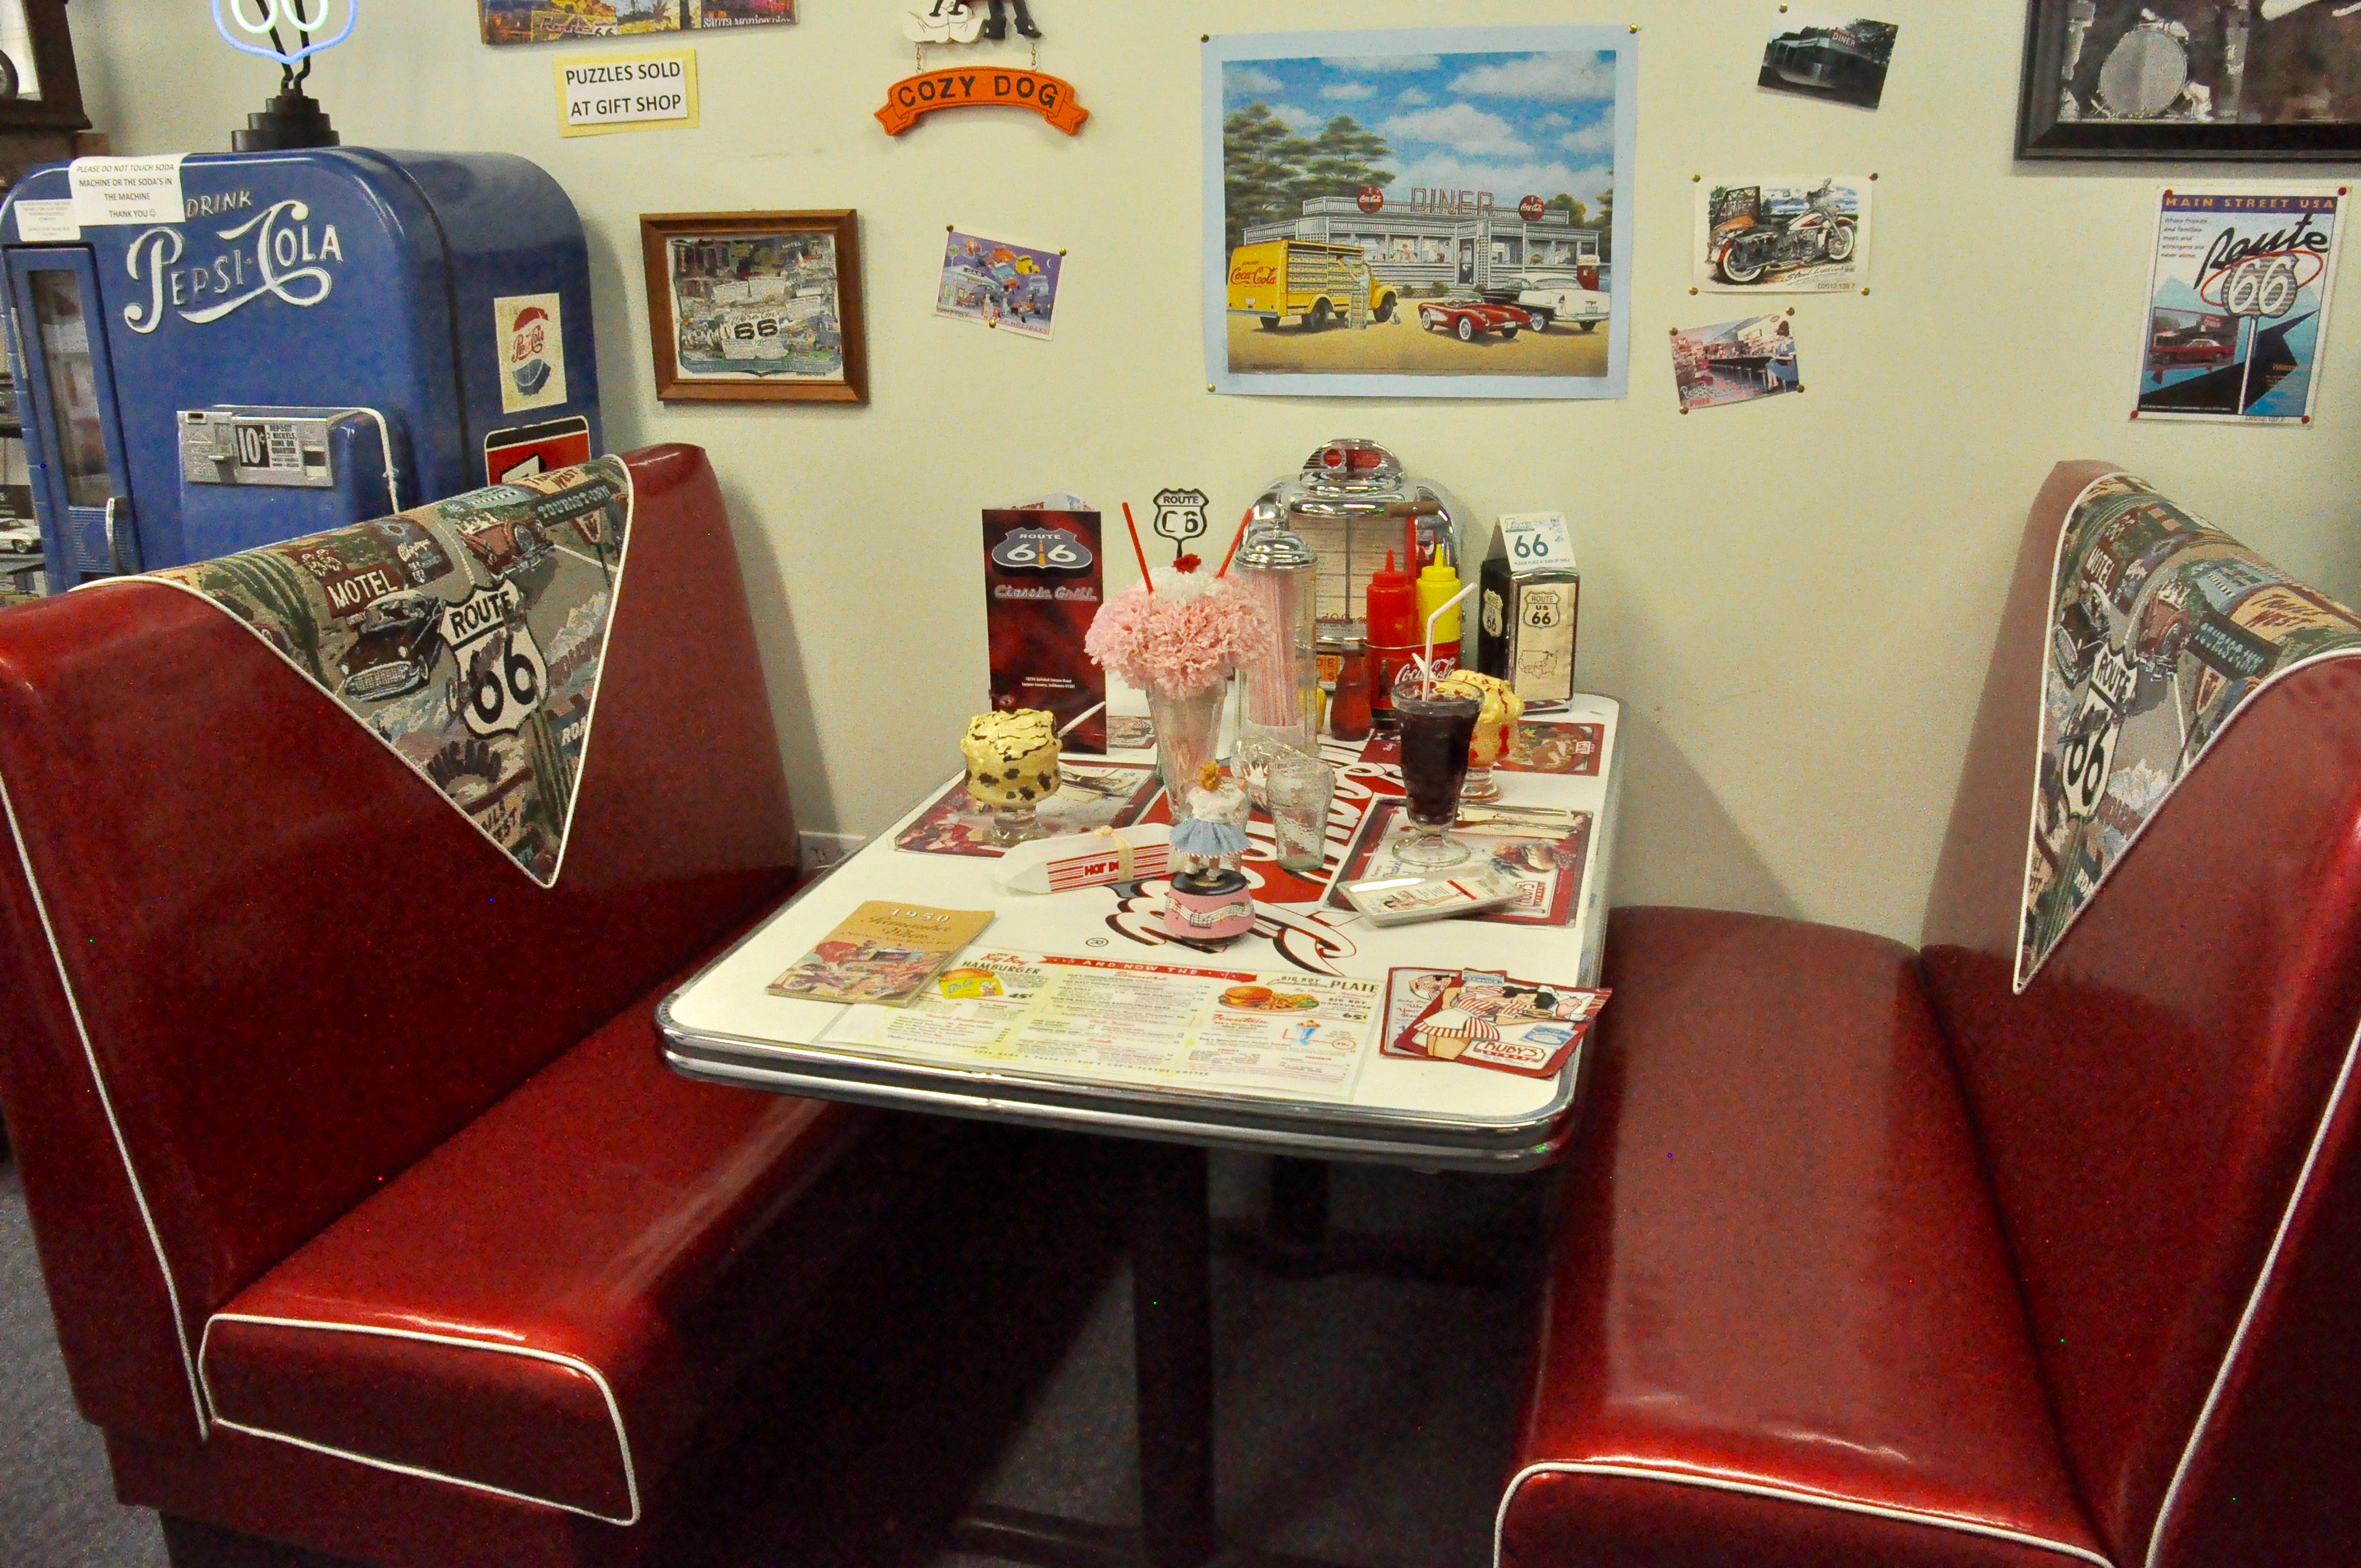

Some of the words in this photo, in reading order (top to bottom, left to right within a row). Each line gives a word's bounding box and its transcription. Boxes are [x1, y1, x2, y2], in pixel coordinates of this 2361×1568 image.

[1832, 32, 1856, 47] DINER
[565, 65, 633, 86] PUZZLES
[638, 61, 681, 80] SOLD
[897, 75, 976, 108] COZY
[994, 74, 1059, 108] DOG
[571, 101, 592, 117] AT
[596, 97, 632, 116] GIFT
[635, 94, 682, 112] SHOP
[79, 179, 111, 187] MACHINE
[123, 178, 137, 187] THE
[138, 178, 164, 186] SODA'S
[118, 193, 151, 201] MACHINE
[186, 190, 253, 219] DRINK
[1411, 186, 1495, 217] DINER
[2165, 198, 2214, 207] MAIN
[2224, 198, 2289, 208] STREET
[2300, 199, 2334, 209] USA
[109, 210, 133, 218] THANK
[133, 209, 149, 217] YOU
[2193, 211, 2329, 291] Route
[1230, 266, 1277, 285] Coca-Cola
[2228, 255, 2289, 314] 66
[1163, 495, 1199, 505] ROUTE
[1514, 533, 1550, 559] 66
[2086, 545, 2115, 590] MOTEL
[327, 569, 398, 609] MOTEL
[994, 584, 1052, 600] Classic
[1054, 586, 1098, 602] Grill
[1531, 595, 1554, 603] ROUTE
[449, 590, 513, 639] ROUTE
[1531, 611, 1552, 625] 66
[1084, 862, 1107, 876] HOT
[889, 908, 951, 923] 1950
[962, 960, 1042, 975] HAMBURGER
[980, 952, 1003, 963] Big
[1004, 955, 1029, 967] Boy
[1082, 960, 1117, 968] AND
[1123, 962, 1158, 972] NOW
[1168, 967, 1199, 975] THE
[1330, 979, 1380, 993] PLATE
[1483, 1040, 1542, 1058] RUBY'S
